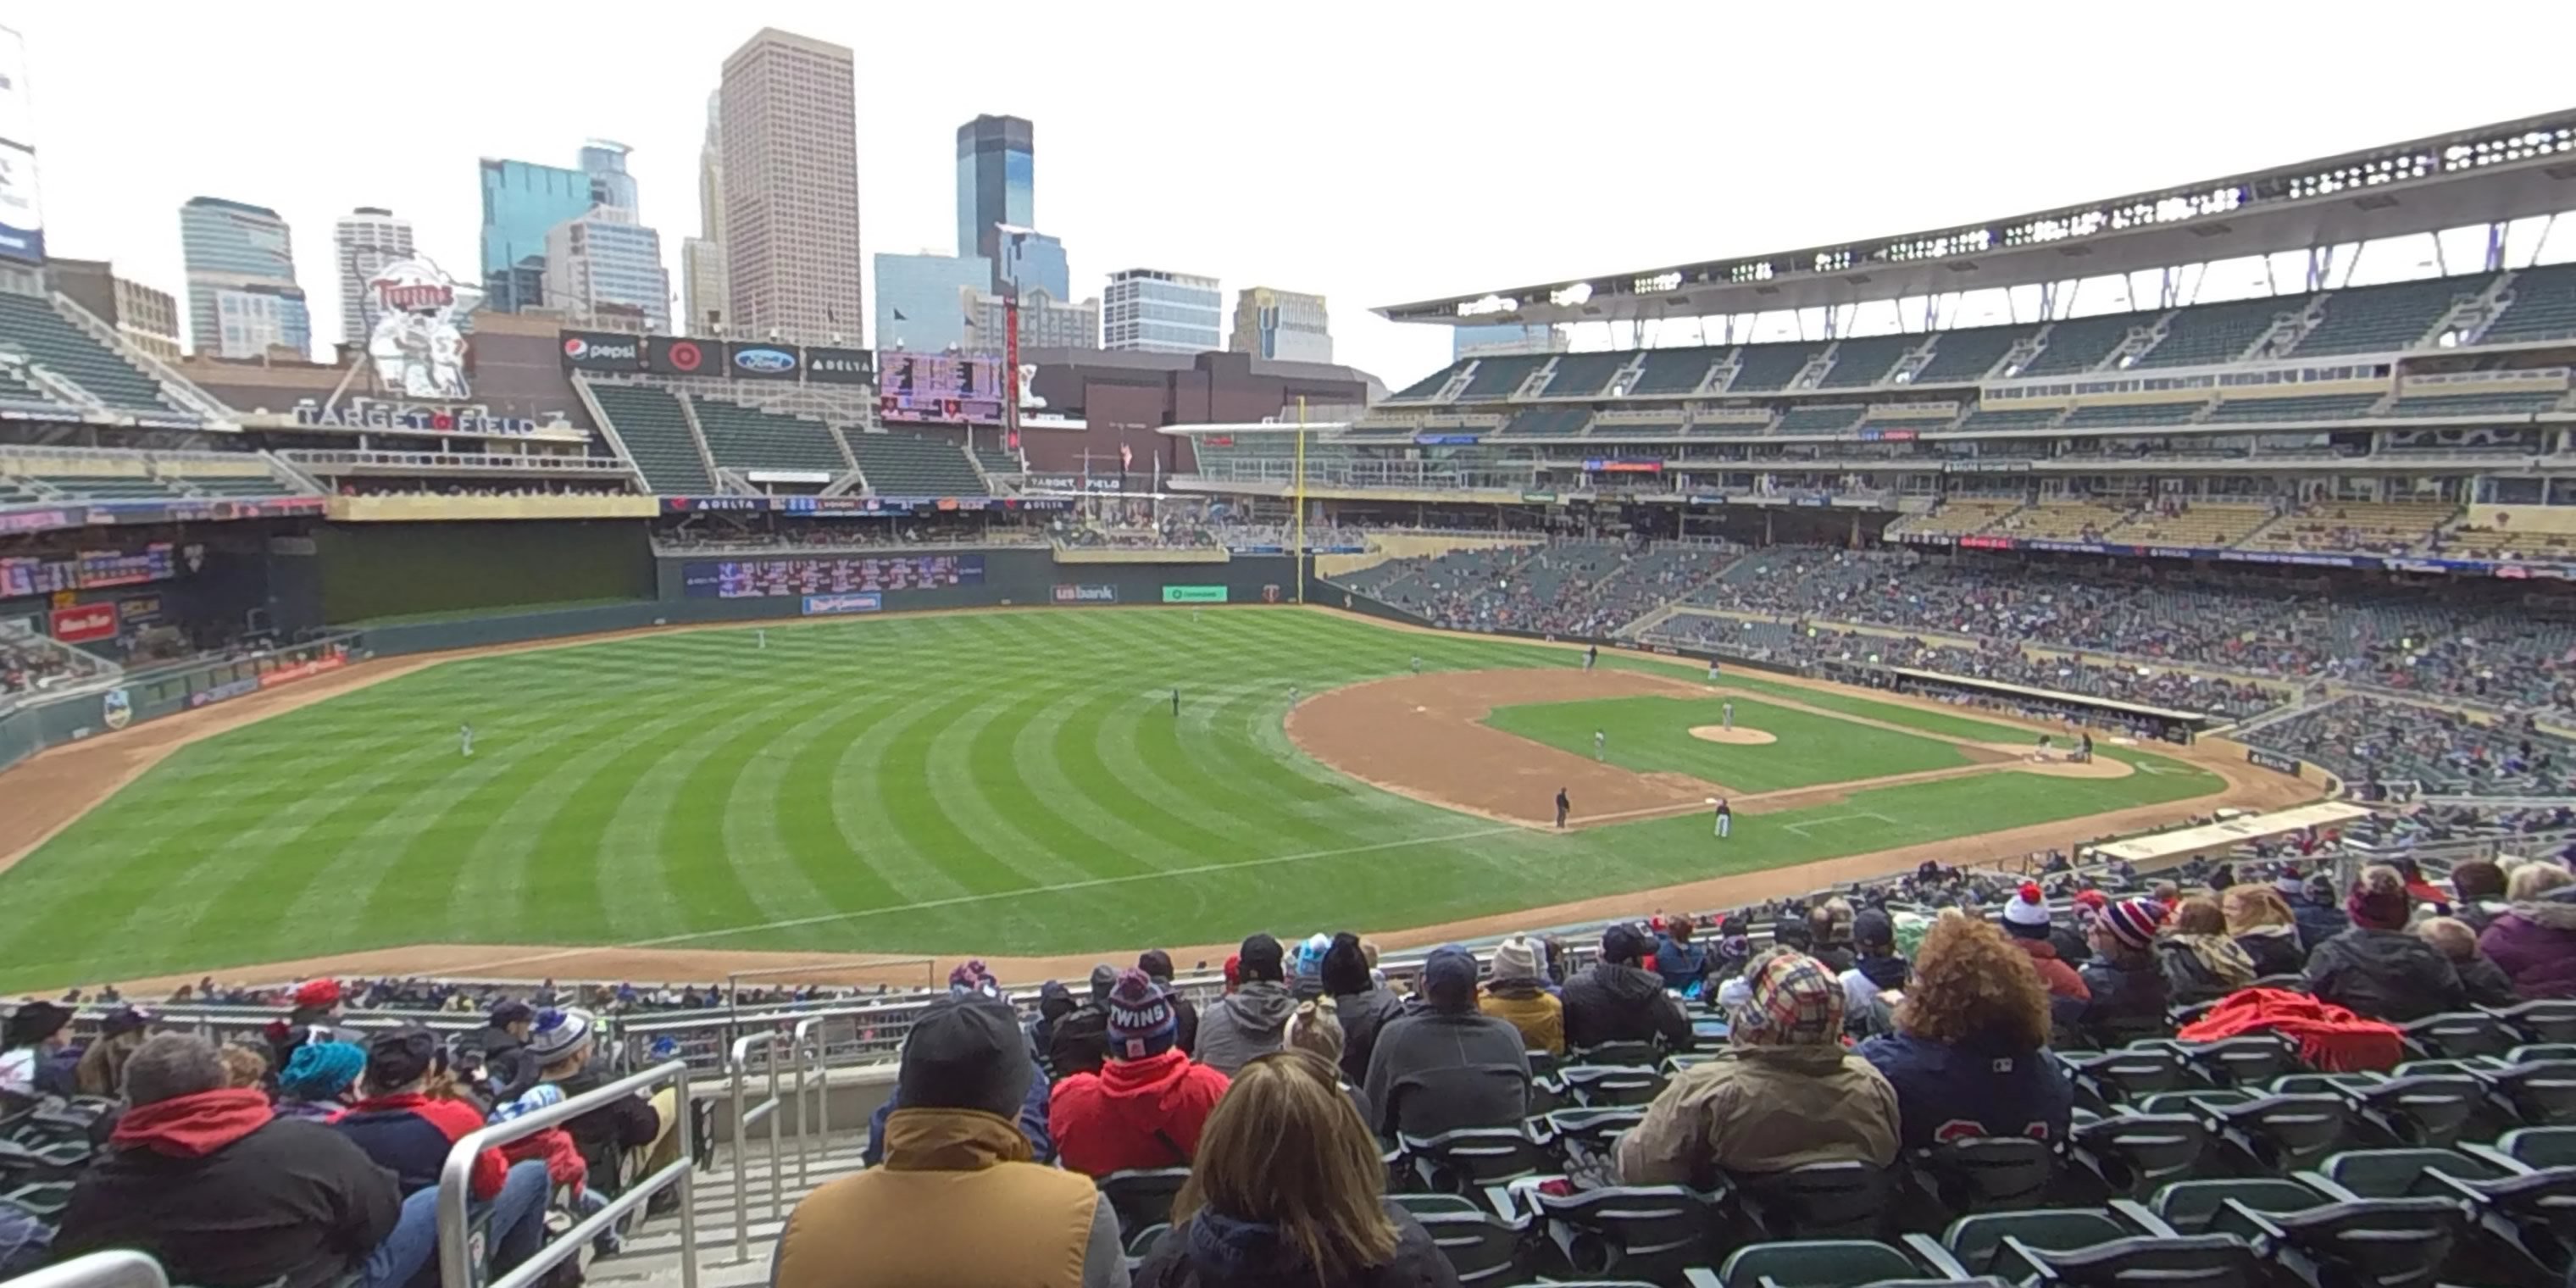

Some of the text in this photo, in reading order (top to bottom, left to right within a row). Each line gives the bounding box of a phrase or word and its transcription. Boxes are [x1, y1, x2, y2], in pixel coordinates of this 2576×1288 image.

[369, 278, 454, 308] Twins
[590, 344, 635, 358] pepsi
[746, 354, 781, 369] Ford
[825, 359, 869, 373] DELTA
[296, 407, 536, 435] TARGET FIELD
[1030, 477, 1074, 487] TARGET
[711, 499, 754, 509] DELTA
[1033, 501, 1064, 509] DELTA
[1110, 1003, 1164, 1028] TWINS
